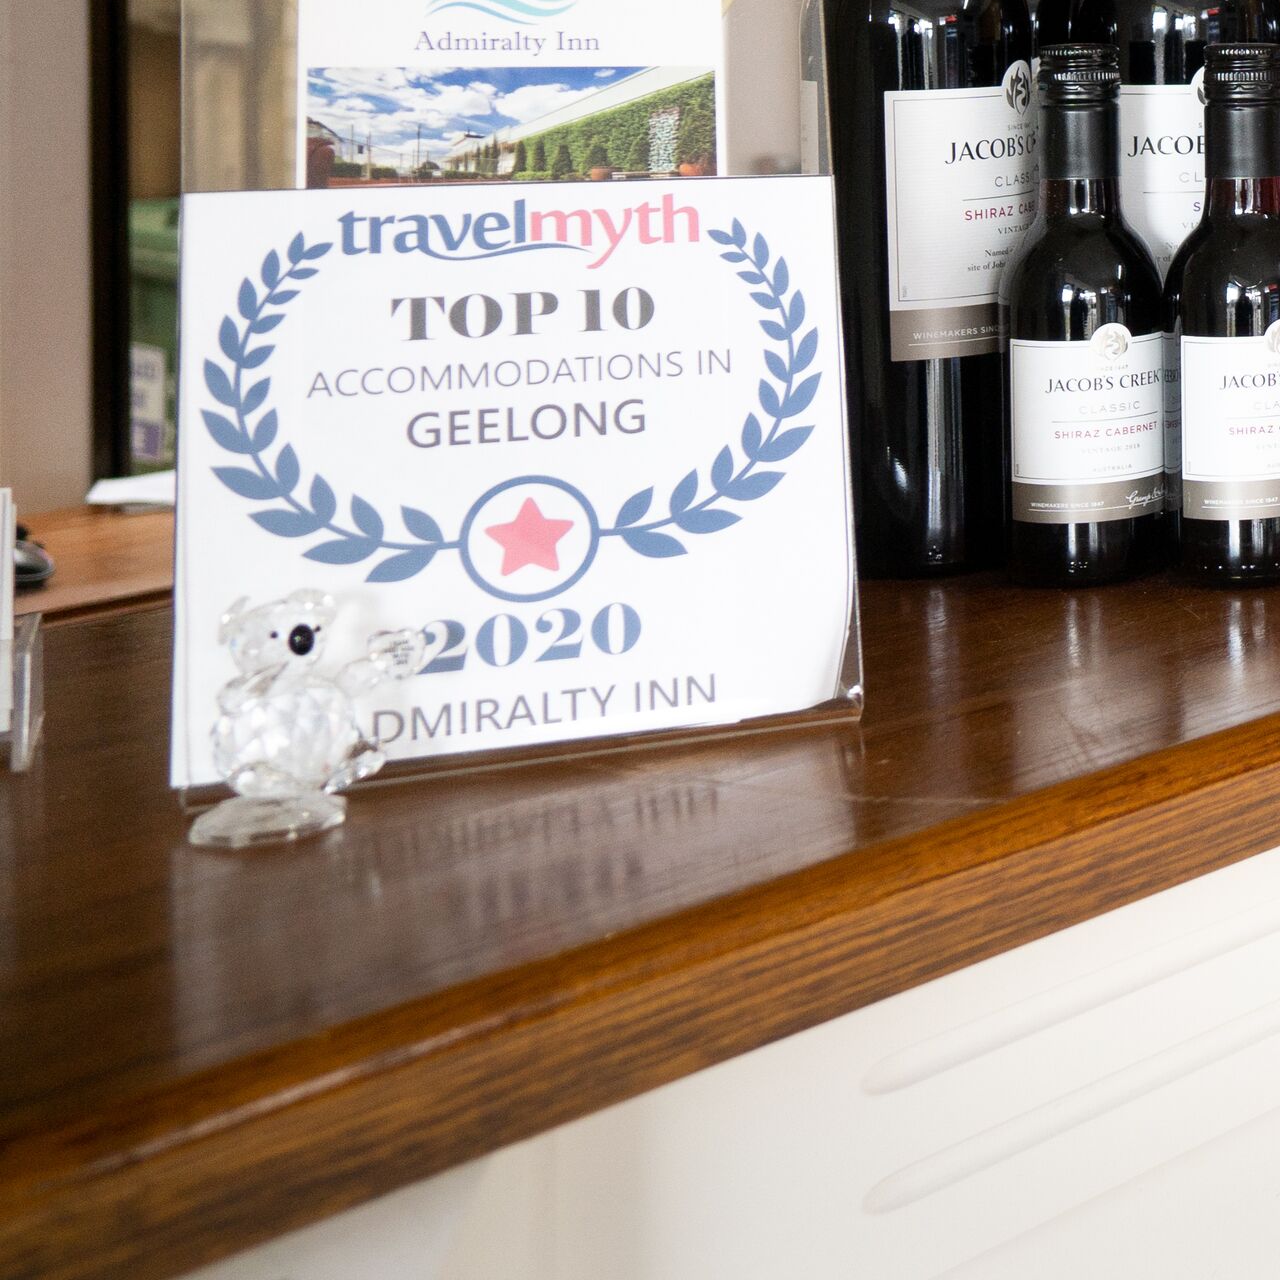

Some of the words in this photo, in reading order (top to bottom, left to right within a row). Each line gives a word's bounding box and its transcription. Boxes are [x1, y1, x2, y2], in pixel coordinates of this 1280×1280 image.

[414, 30, 547, 57] Admiralty
[556, 31, 600, 51] Inn
[944, 134, 1024, 165] JACOB'S
[994, 172, 1030, 188] CLASS
[964, 205, 1014, 221] SHIRAZ
[337, 193, 701, 269] travelmyth
[391, 290, 559, 342] TOP
[577, 286, 655, 332] 10
[913, 327, 978, 341] WINEMAKERS
[306, 351, 684, 399] ACCOMMODATIONS
[697, 348, 732, 376] IN
[1045, 376, 1114, 394] JACOB'S
[1079, 400, 1141, 415] CLASSIC
[406, 398, 646, 449] GEELONG
[1054, 429, 1100, 439] SHIRAZ
[1105, 421, 1158, 437] CABERNET
[1228, 425, 1274, 436] SHIRAZ
[415, 601, 642, 675] 2020
[362, 684, 617, 744] DMIRALTY
[634, 673, 717, 713] INN
